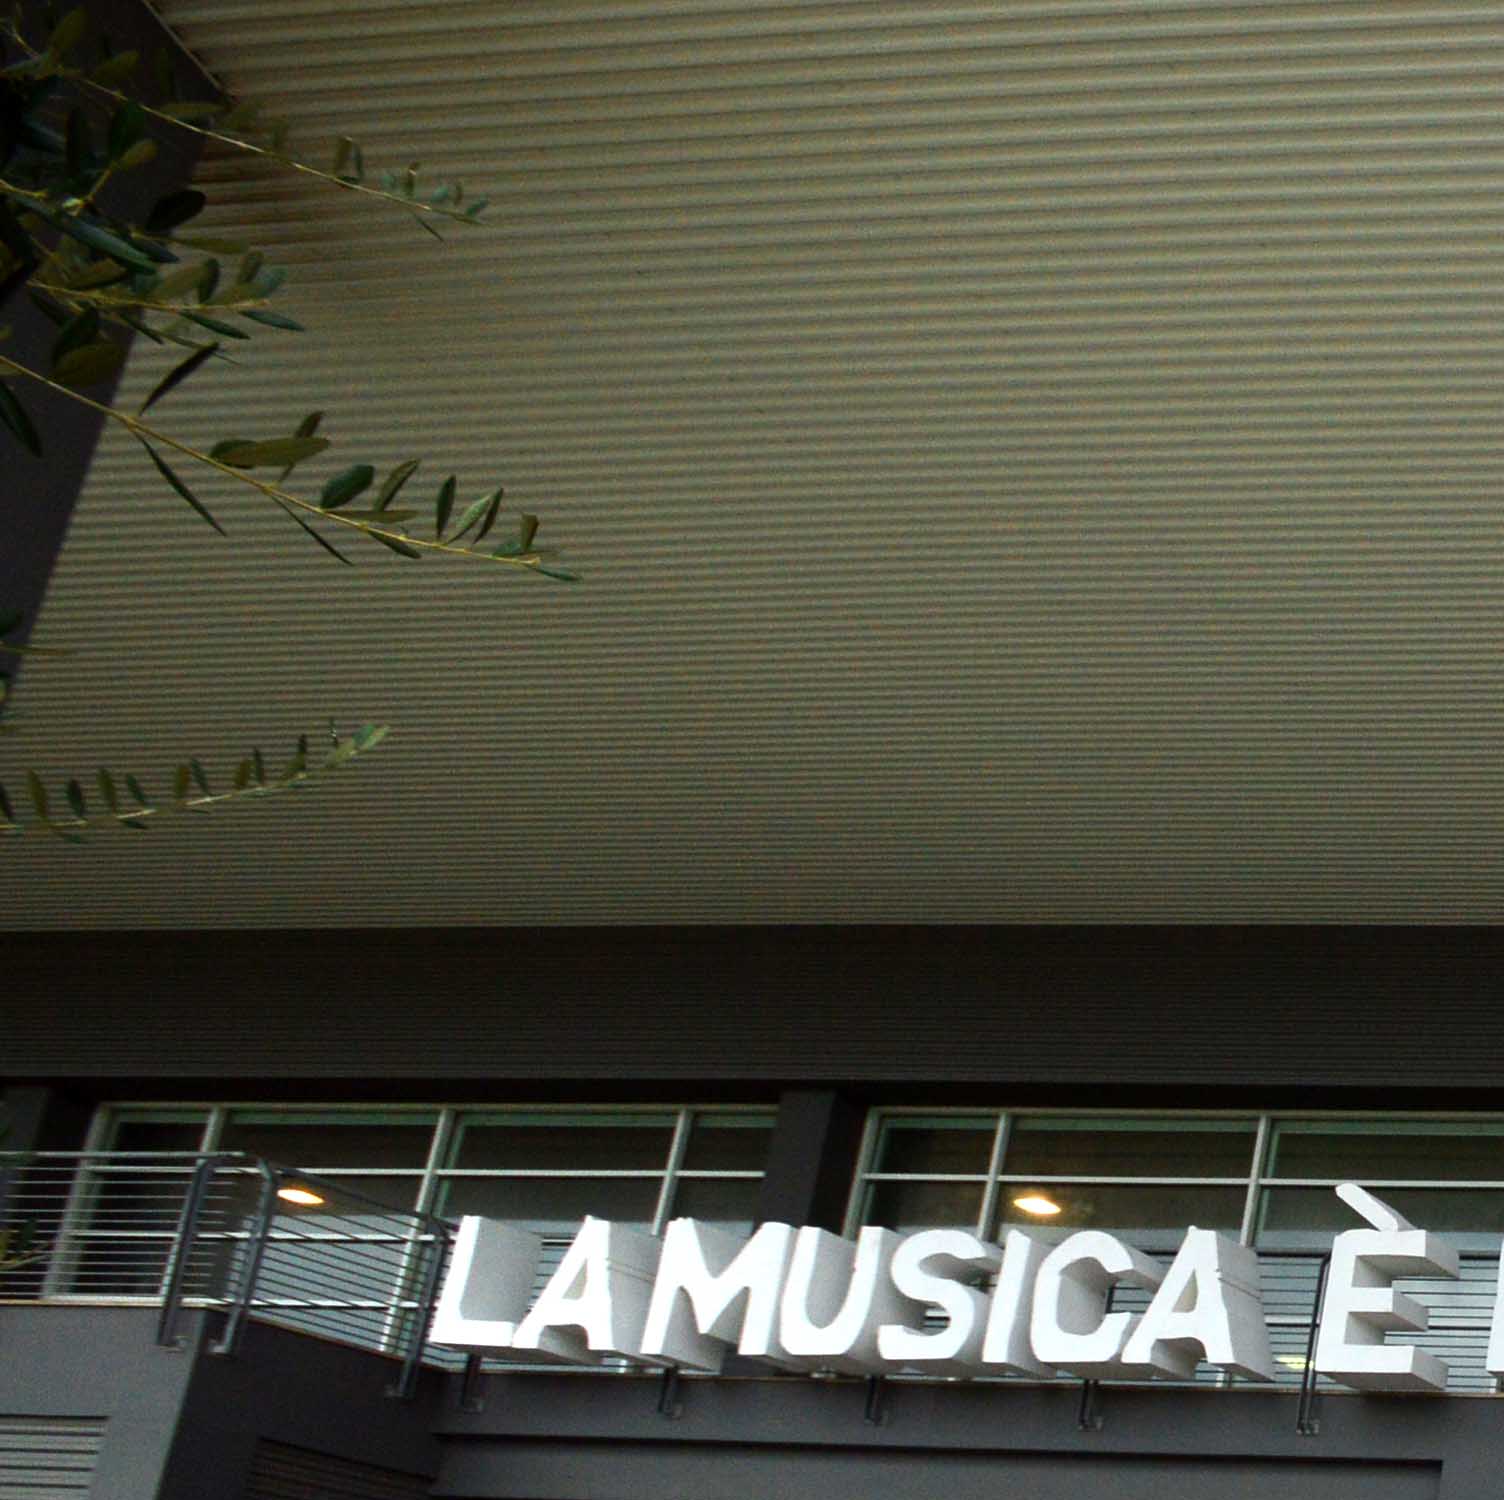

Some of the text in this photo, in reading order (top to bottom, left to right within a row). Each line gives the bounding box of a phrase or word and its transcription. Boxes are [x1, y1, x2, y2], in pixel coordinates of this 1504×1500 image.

[428, 1214, 630, 1356] LA
[640, 1215, 1258, 1374] MUSICA
[1314, 1182, 1455, 1389] È
